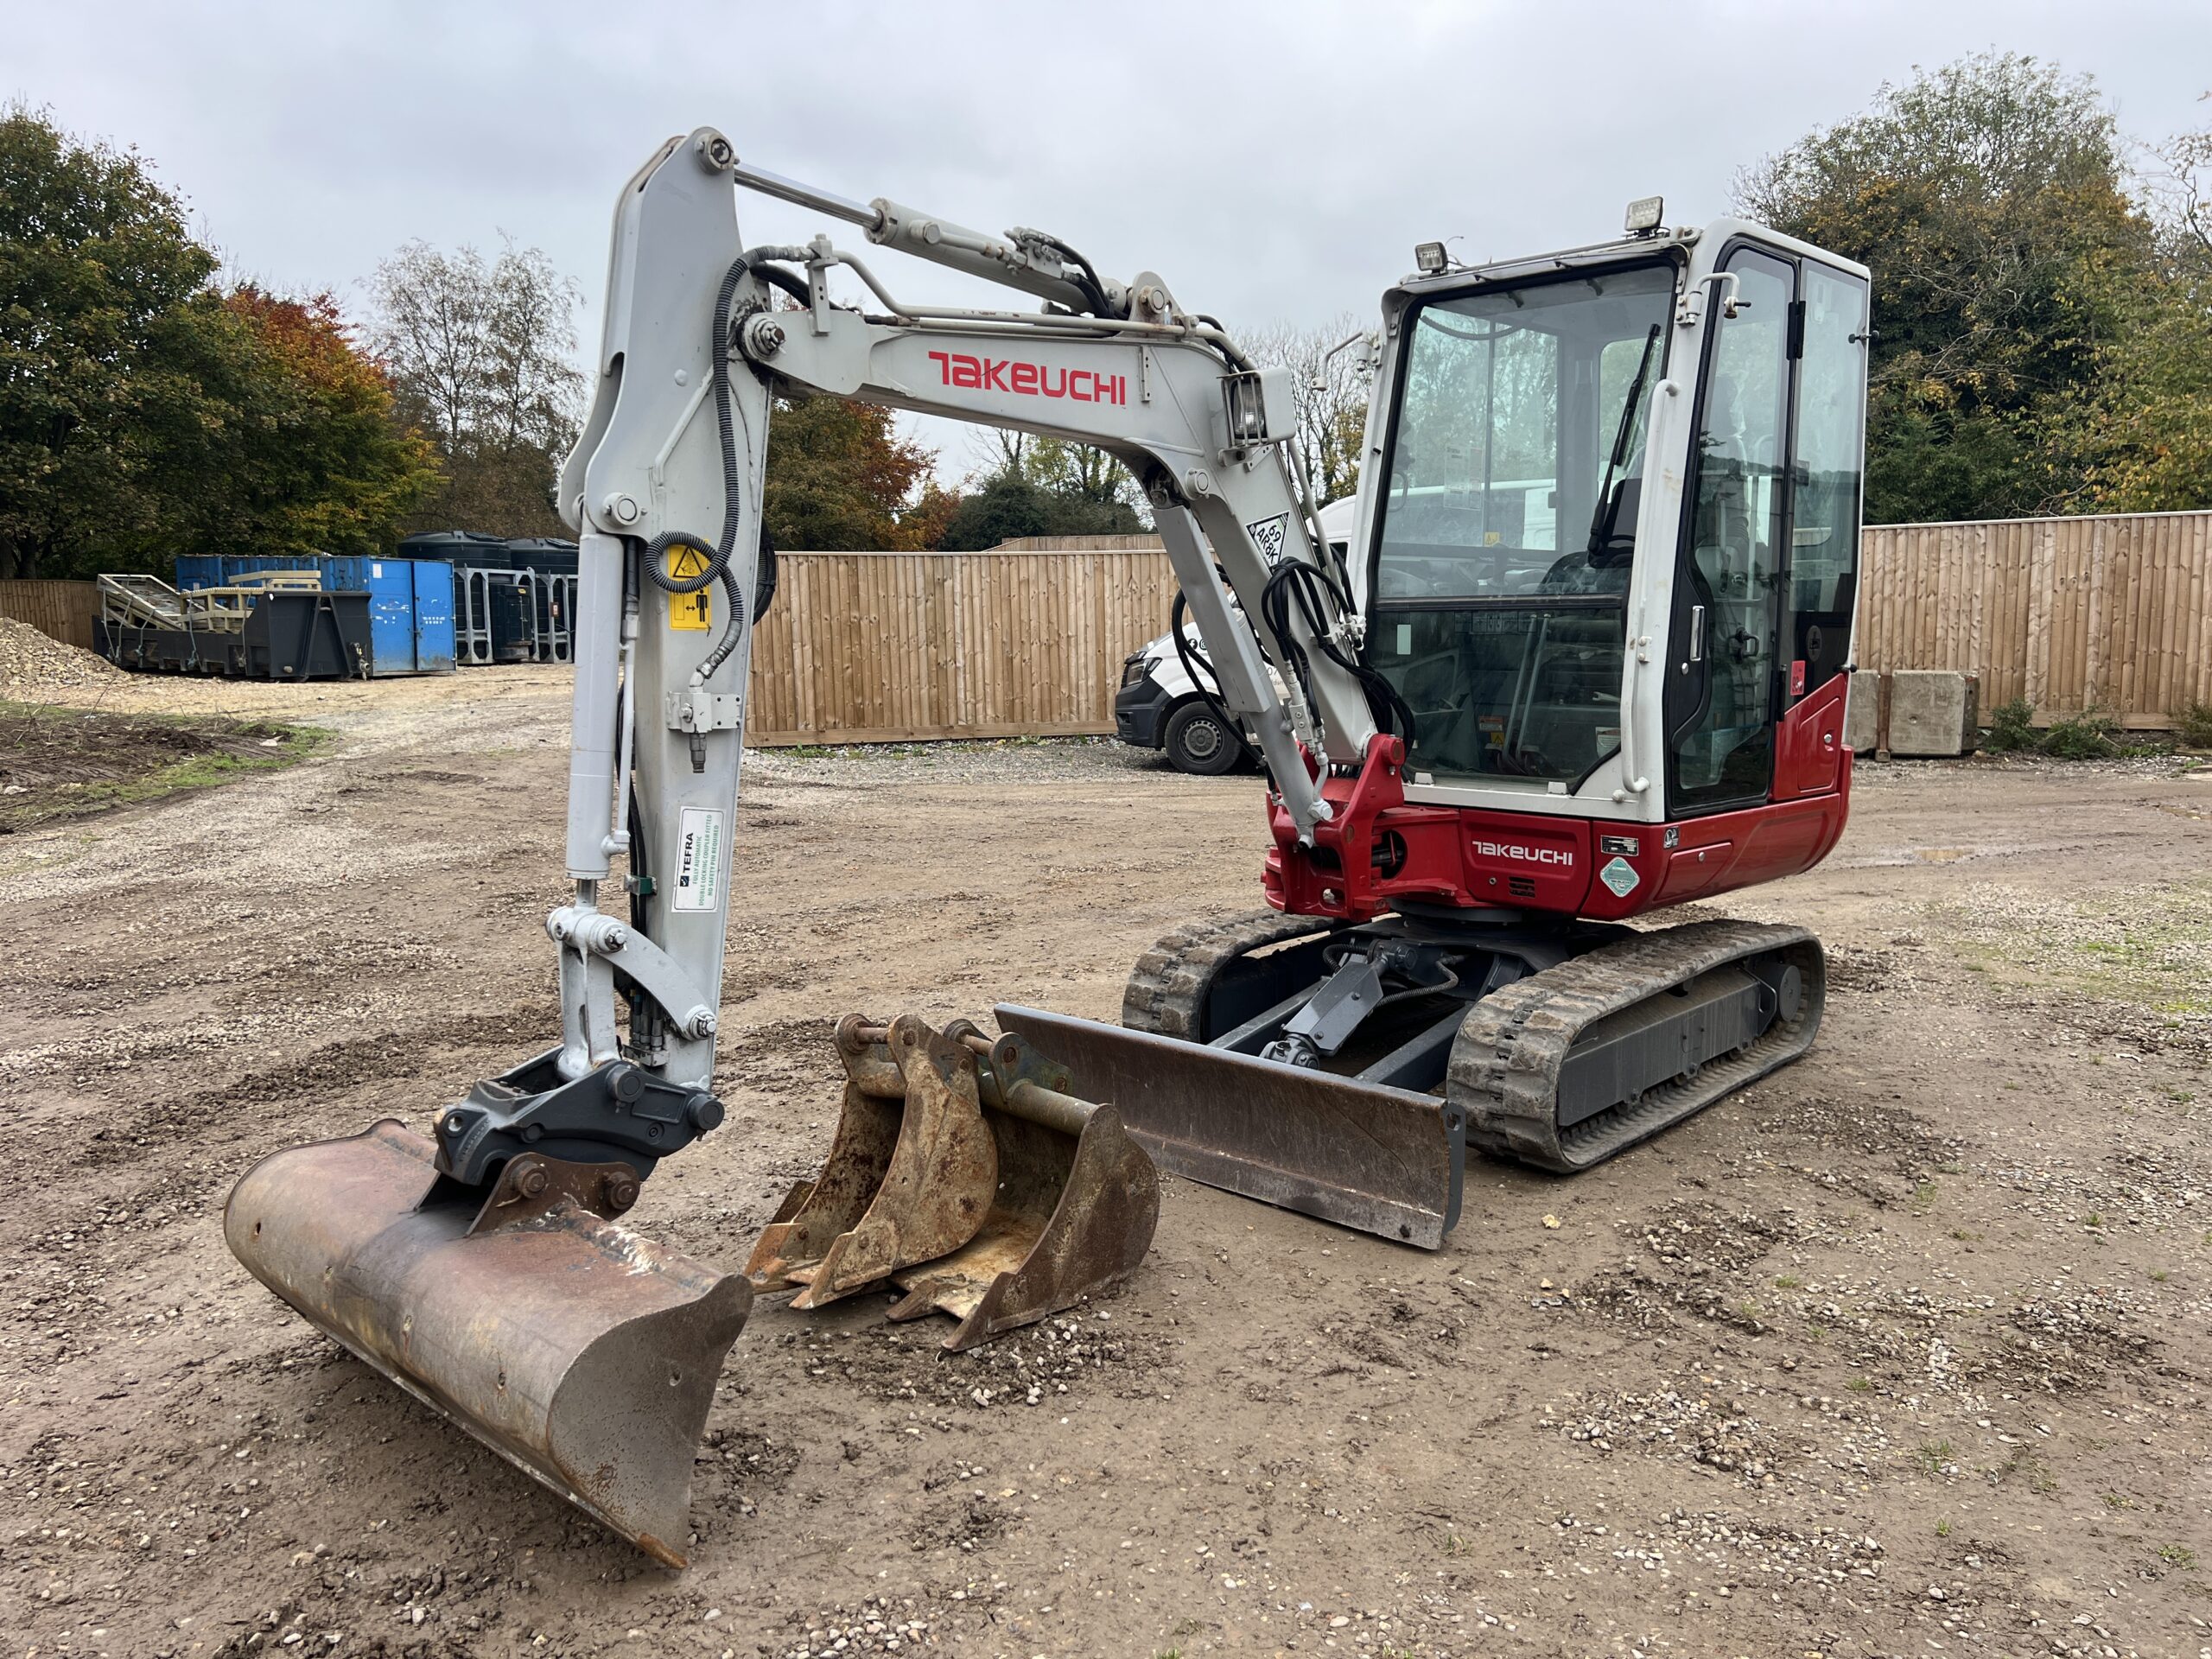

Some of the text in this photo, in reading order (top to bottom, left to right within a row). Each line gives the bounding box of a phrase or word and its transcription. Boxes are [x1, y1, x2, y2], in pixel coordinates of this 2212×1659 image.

[1256, 527, 1278, 564] AR8K
[1268, 524, 1281, 543] 69
[683, 833, 693, 873] TEFRA
